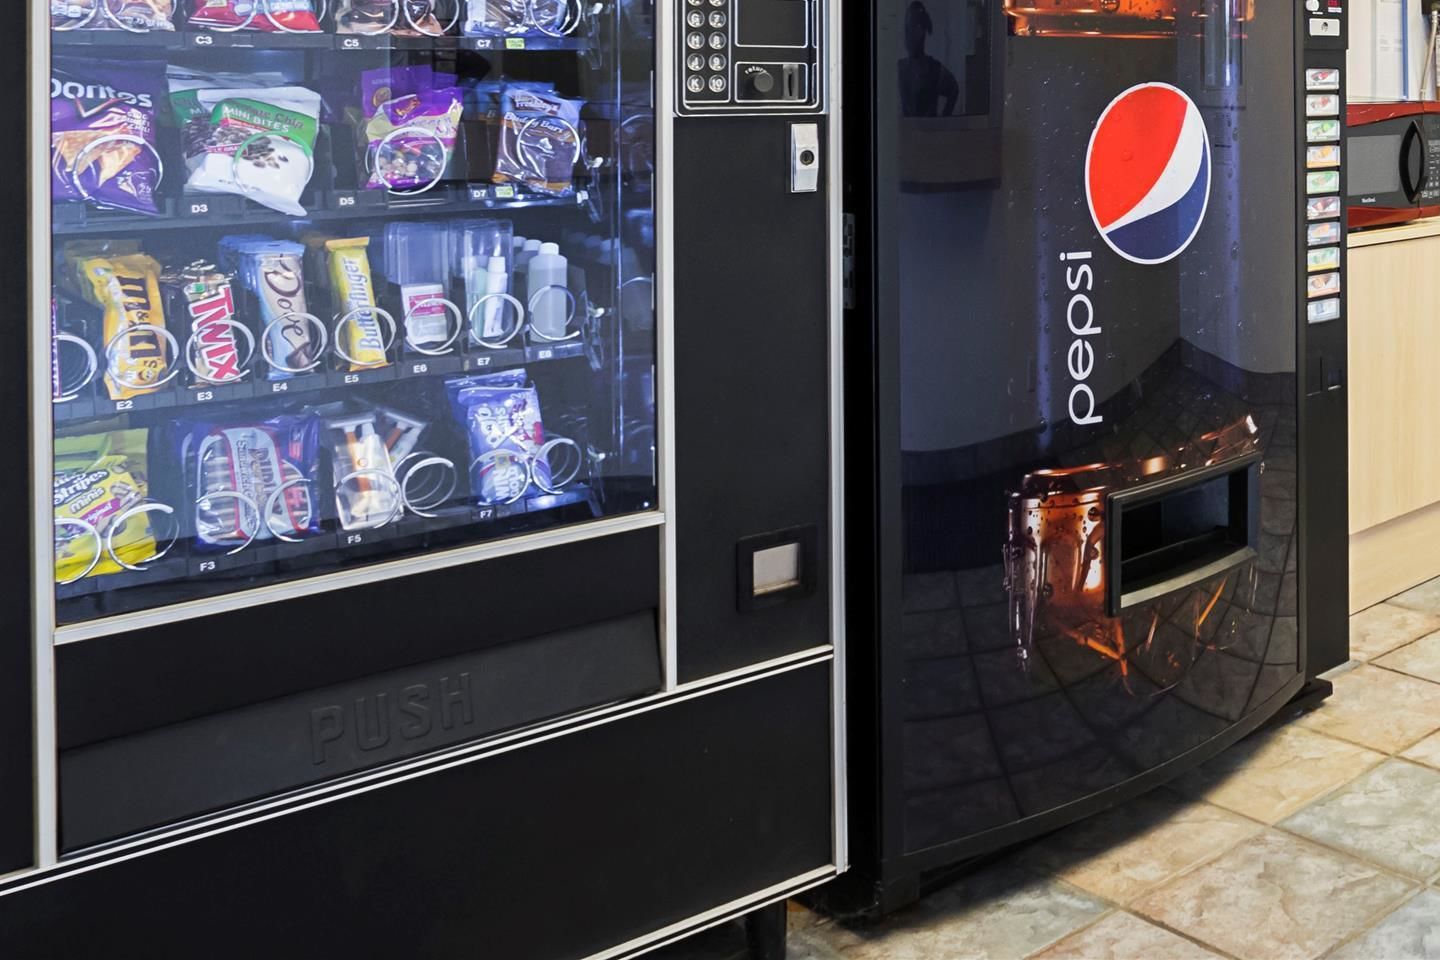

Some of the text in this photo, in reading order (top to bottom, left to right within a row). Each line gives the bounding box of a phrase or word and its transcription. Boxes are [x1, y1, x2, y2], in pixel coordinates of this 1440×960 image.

[195, 35, 213, 45] C3
[343, 38, 360, 48] C5
[476, 39, 491, 49] C7
[223, 106, 250, 120] MINI
[253, 117, 290, 133] BITES
[473, 189, 486, 198] D7
[339, 196, 355, 206] D5
[191, 204, 209, 214] D3
[264, 253, 305, 353] Dove
[343, 259, 383, 352] Butterfinger
[191, 285, 241, 381] TWIX
[1059, 250, 1103, 426] pepsi
[476, 357, 491, 367] E7
[413, 364, 428, 374] E6
[344, 374, 360, 384] E5
[272, 382, 288, 392] E4
[197, 391, 213, 401] E3
[116, 400, 134, 410] E2
[54, 469, 109, 505] Stripes
[70, 487, 105, 514] minis
[85, 501, 113, 524] riginal
[479, 509, 493, 519] F7
[347, 534, 362, 544] F5
[199, 561, 216, 572] F3
[310, 672, 474, 766] PUSH
